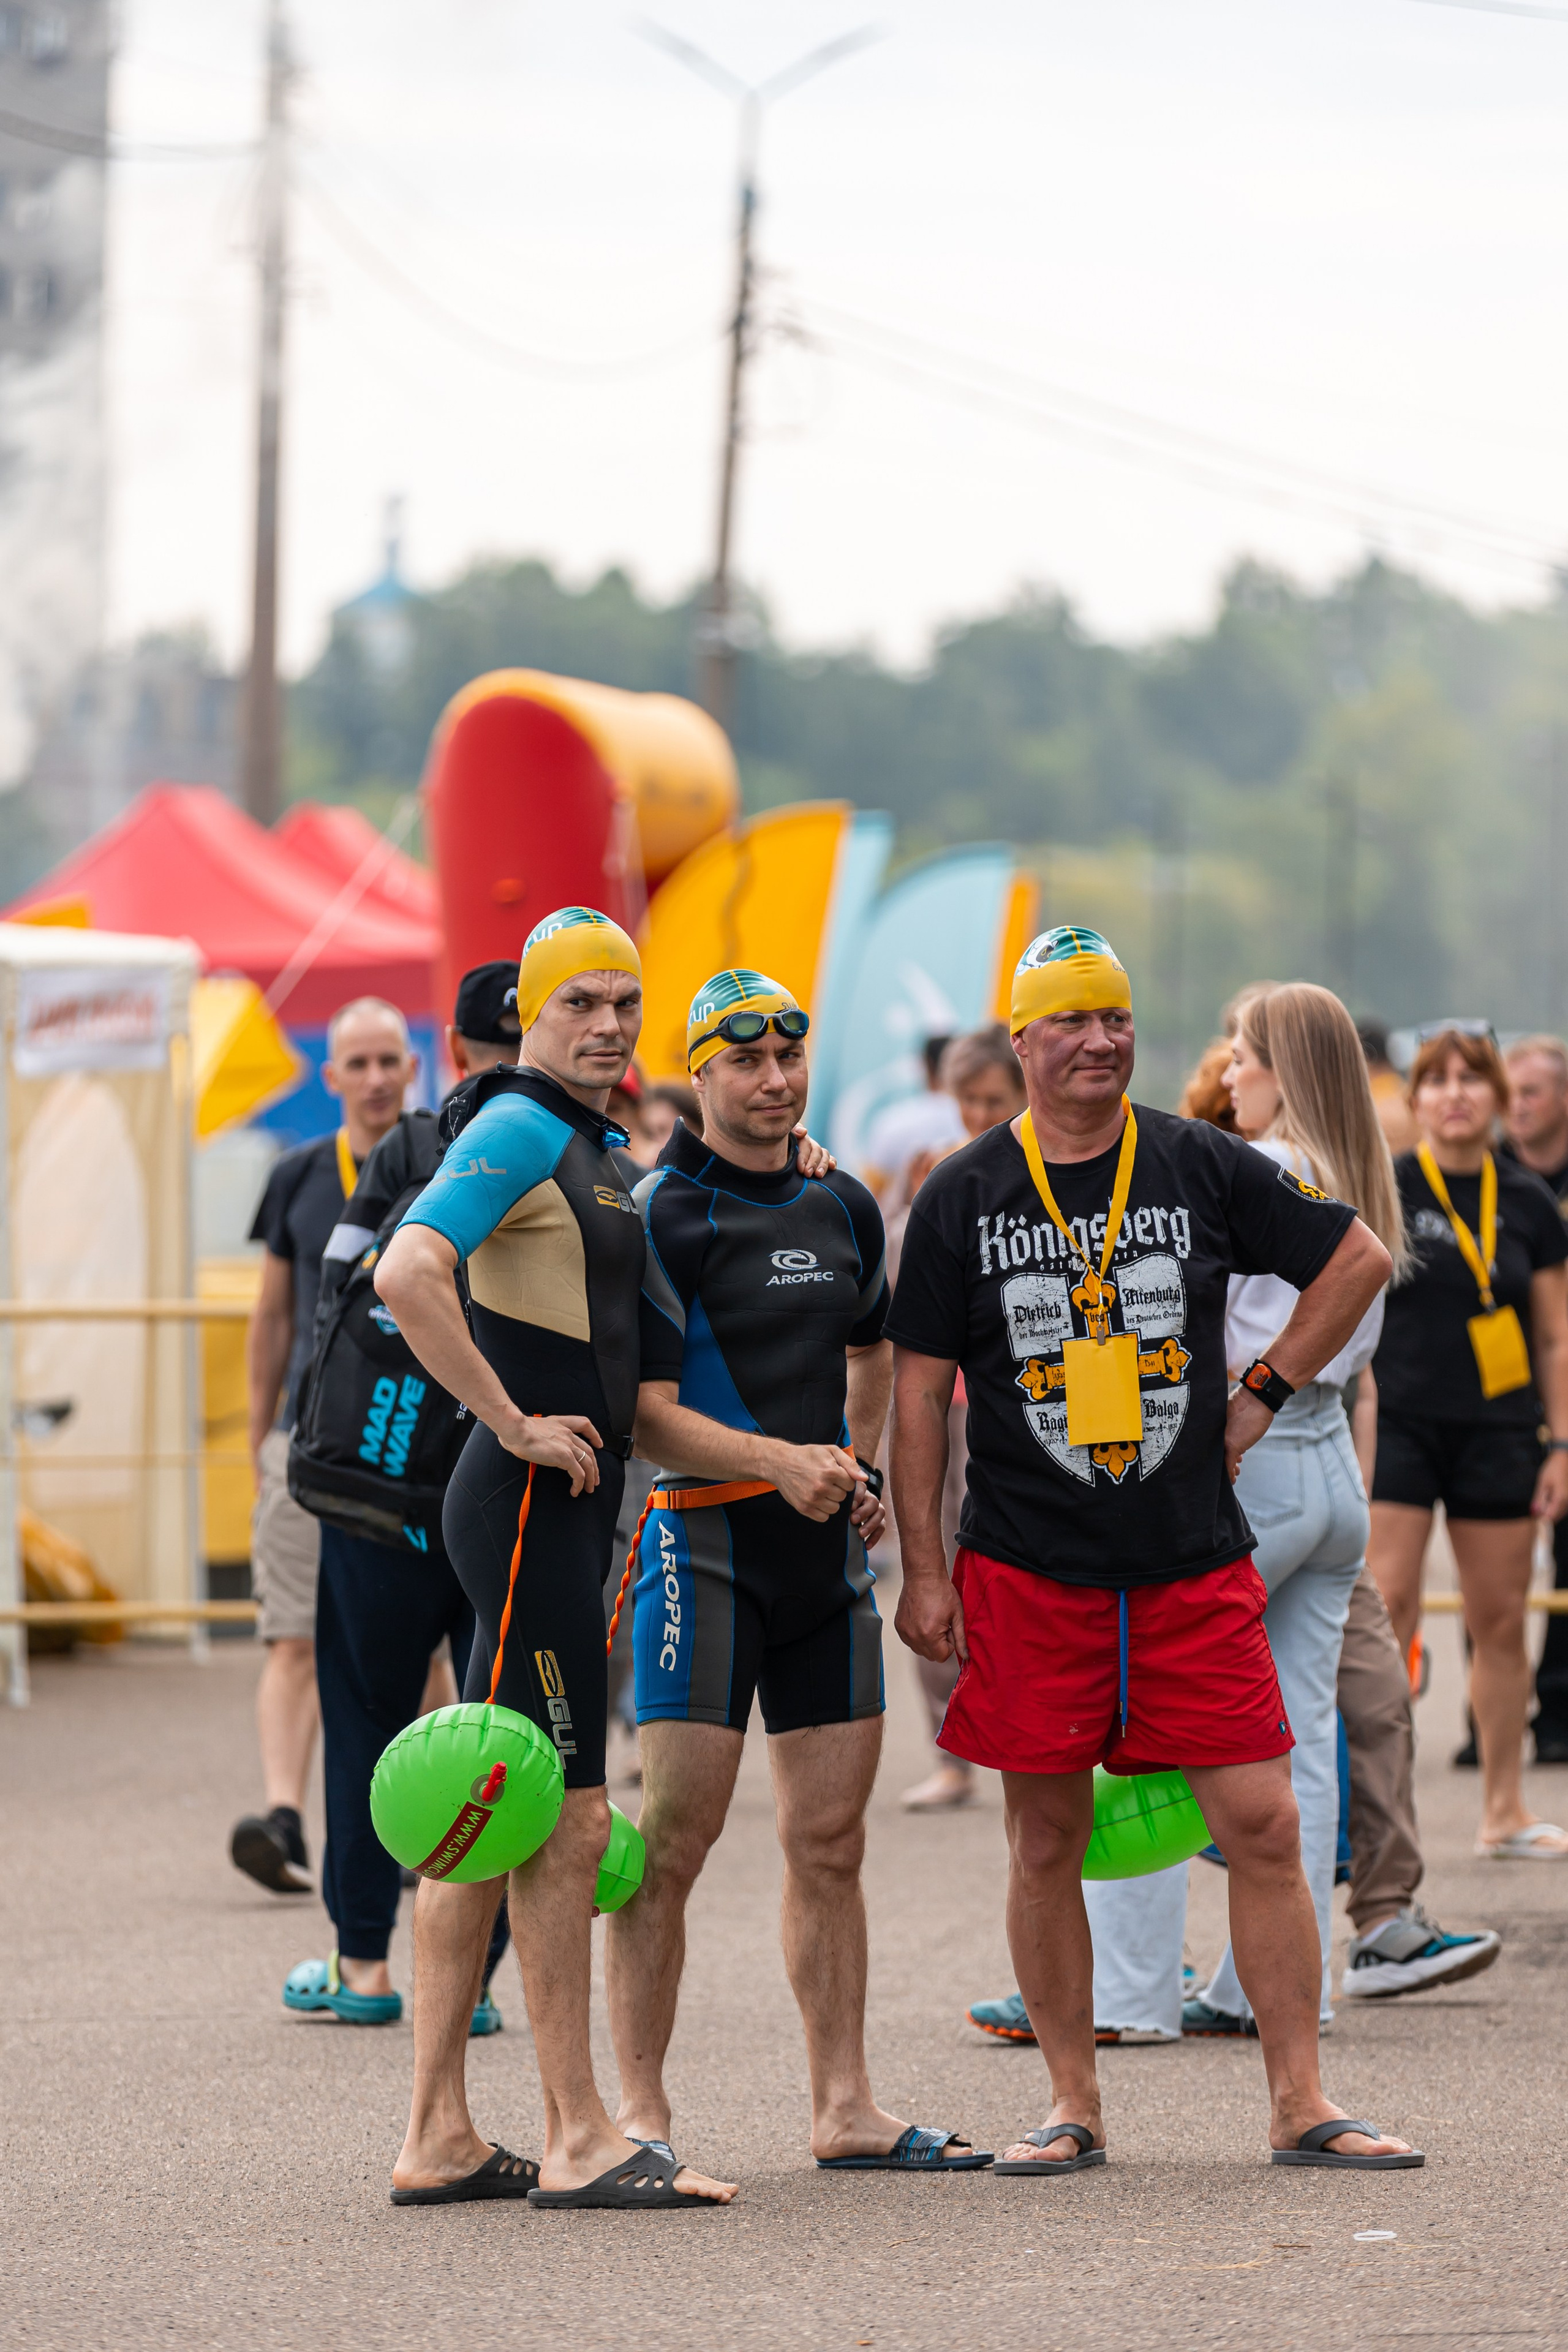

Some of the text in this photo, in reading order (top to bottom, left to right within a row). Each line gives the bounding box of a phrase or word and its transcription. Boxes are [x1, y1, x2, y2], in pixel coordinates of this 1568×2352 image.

[765, 1272, 834, 1286] AROPEC
[358, 1376, 398, 1466] MAD
[382, 1373, 426, 1478] WAVE
[1143, 1398, 1179, 1419] Balga
[658, 1520, 681, 1672] AROPEC
[547, 1697, 577, 1770] GUL
